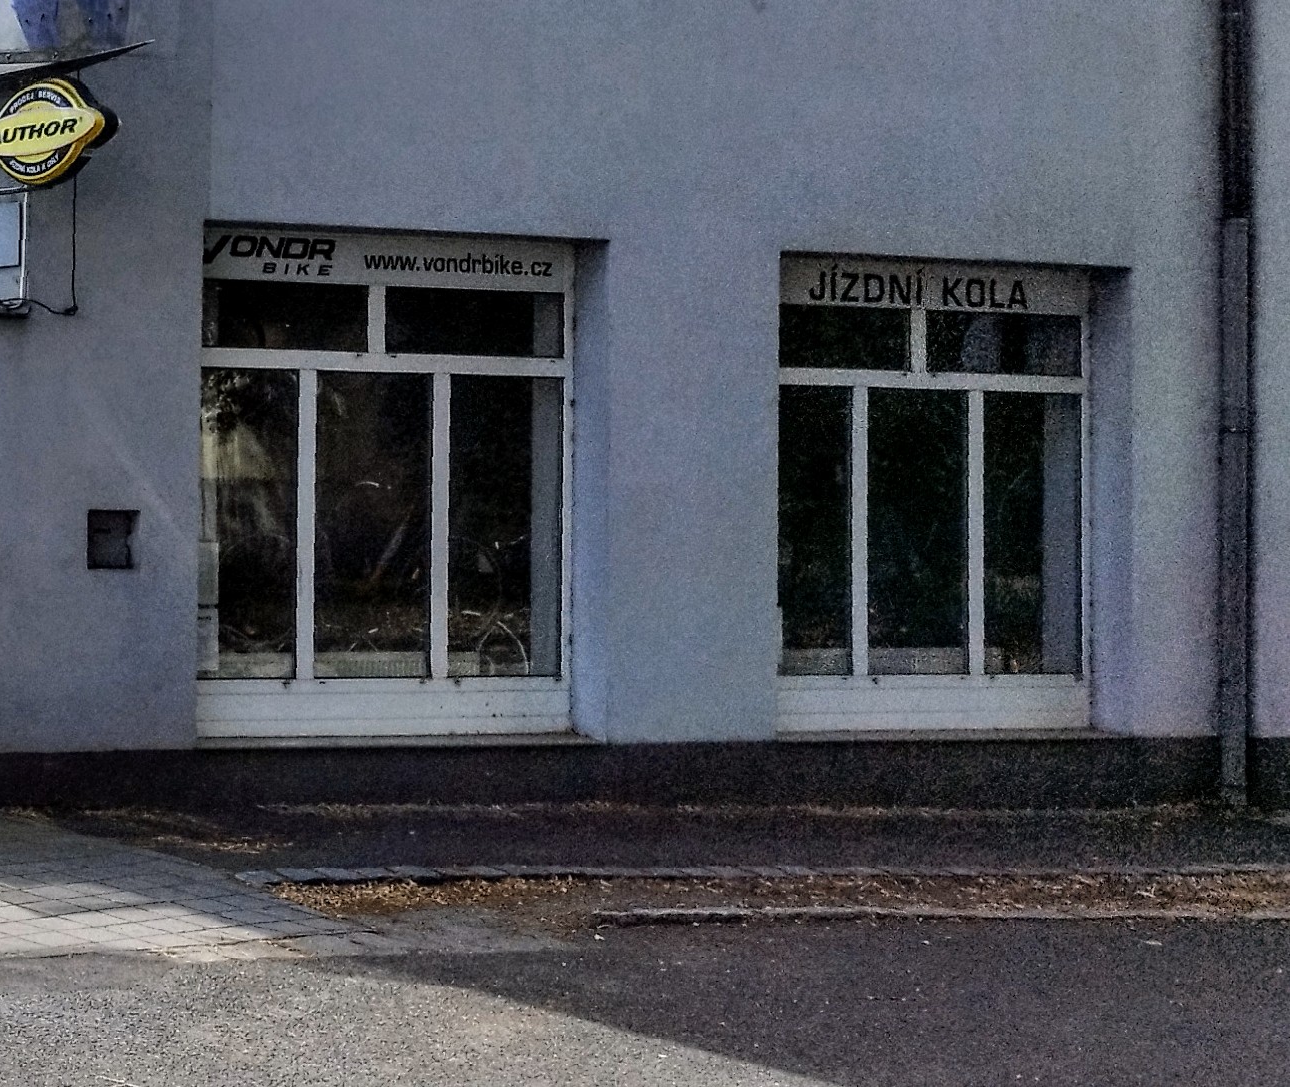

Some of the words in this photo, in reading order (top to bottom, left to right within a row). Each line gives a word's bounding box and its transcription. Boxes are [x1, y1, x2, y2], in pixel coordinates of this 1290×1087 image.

[202, 234, 337, 265] VONDR
[262, 262, 333, 276] BIKE
[363, 252, 553, 278] www.vondrbike.cz
[808, 264, 927, 306] JÍZDNÍ
[942, 276, 1029, 310] KOLA
